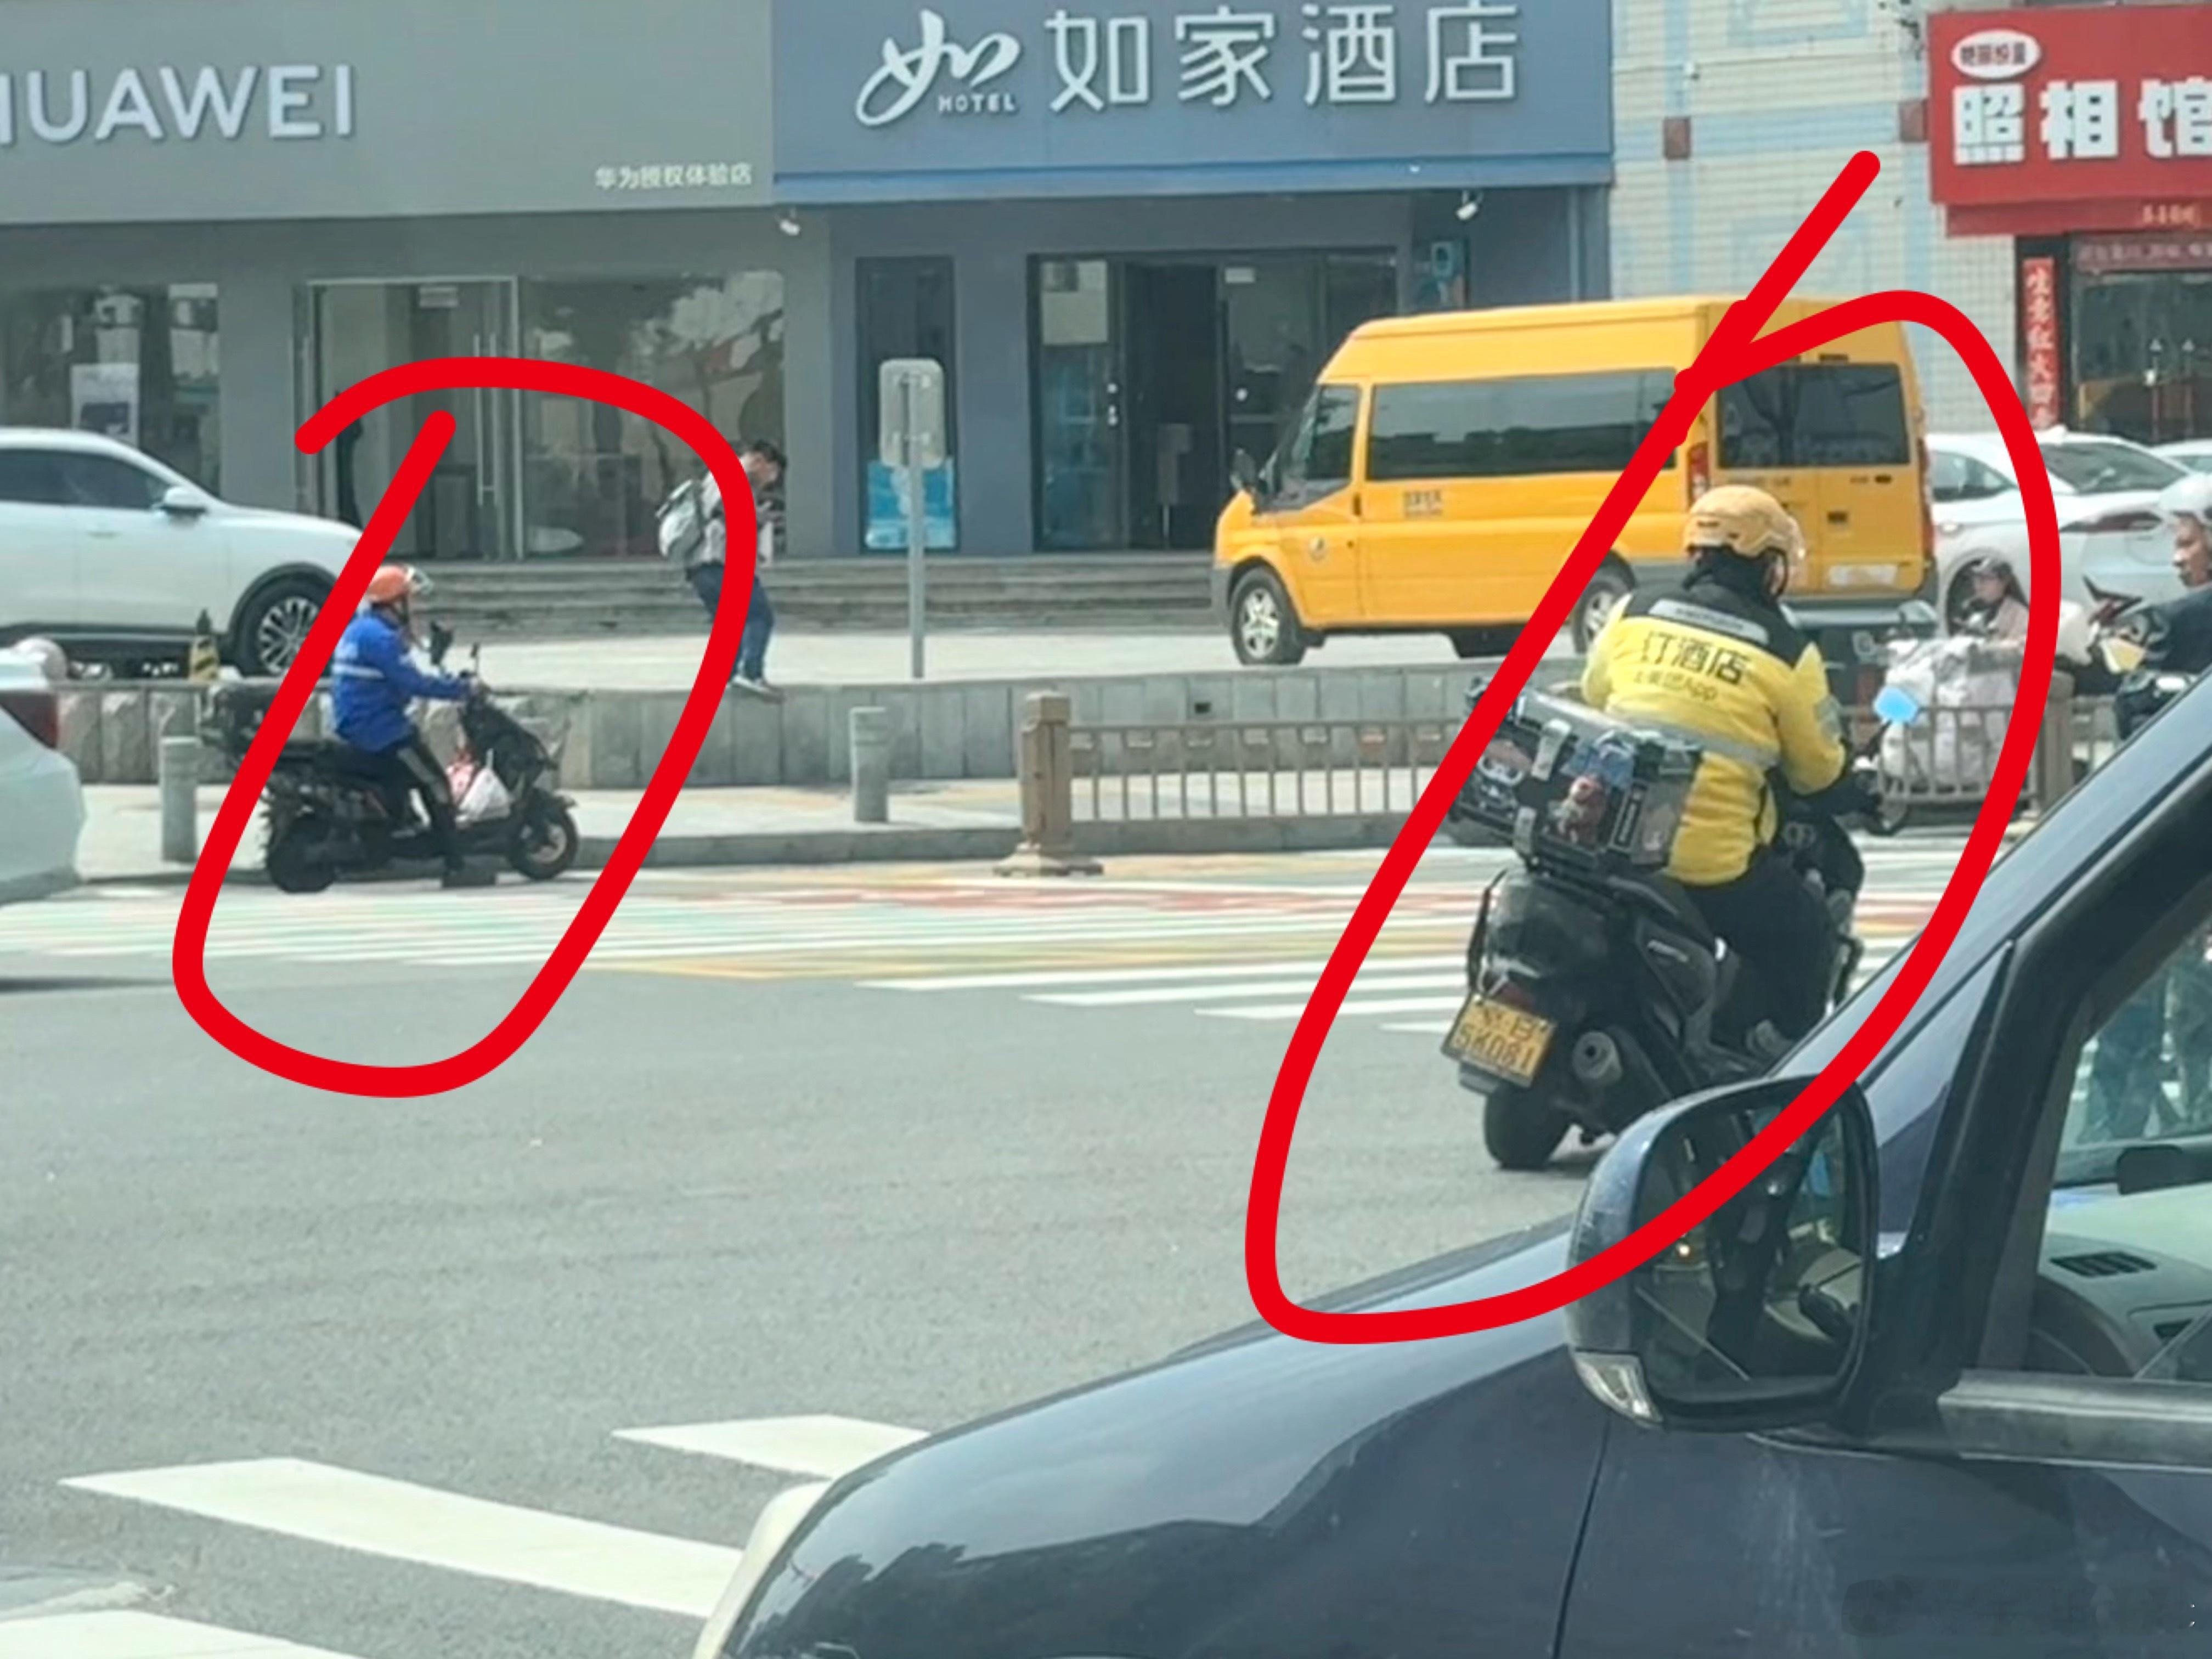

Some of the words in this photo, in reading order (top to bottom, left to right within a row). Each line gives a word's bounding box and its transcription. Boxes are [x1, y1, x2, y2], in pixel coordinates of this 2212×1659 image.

[1044, 0, 1518, 111] 如家酒店
[0, 64, 353, 144] UAWEI
[938, 93, 1017, 113] HOTEL
[1951, 76, 2212, 165] 照相馆
[595, 162, 752, 189] 华为授权体验店
[1640, 629, 1750, 686] 订酒店
